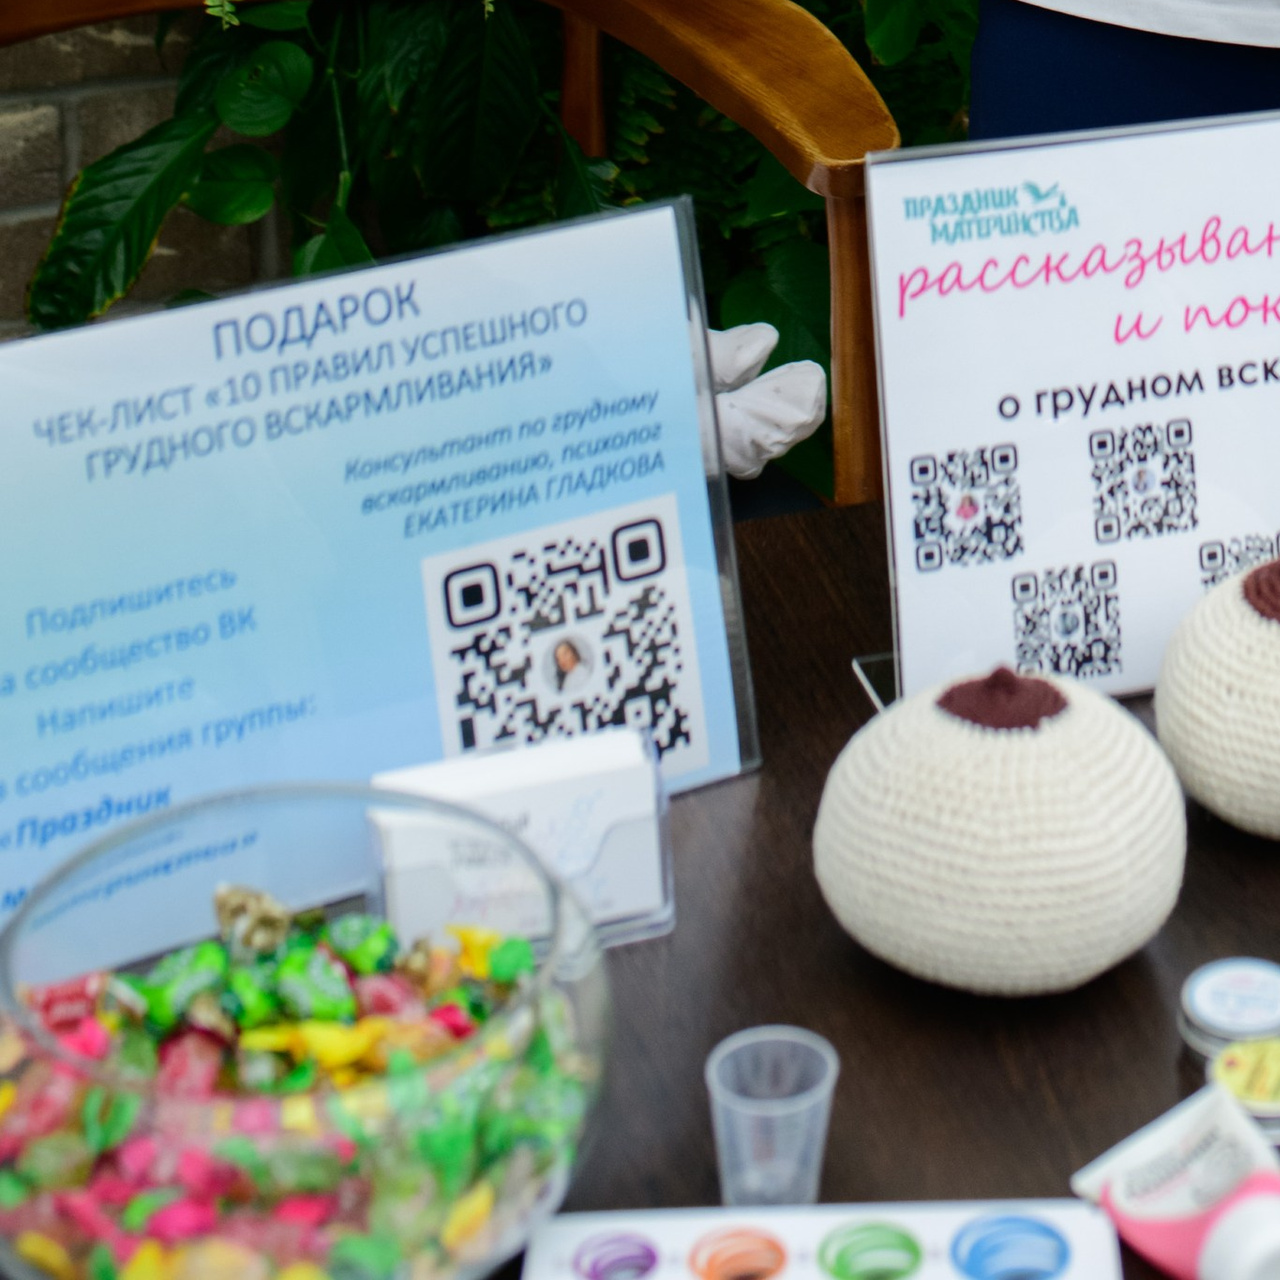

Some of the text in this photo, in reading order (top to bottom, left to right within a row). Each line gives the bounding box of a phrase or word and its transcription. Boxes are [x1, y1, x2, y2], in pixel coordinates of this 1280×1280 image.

[903, 186, 1019, 220] ПРАЗДНИК
[929, 206, 1080, 246] МАТЕРИНСТВА
[212, 279, 421, 361] ПОДАРОК
[1113, 311, 1163, 345] и
[33, 384, 196, 448] ЧЕК-ЛИСТ
[269, 340, 396, 396] ПРАВИЛ
[401, 297, 588, 367] УСПЕШНОГО
[998, 395, 1021, 421] о
[1035, 370, 1204, 421] грудном
[84, 350, 554, 482] ГРУДНОГО ВСКАРМЛИВАНИЯ»
[344, 389, 660, 484] Консультант по грудному
[361, 422, 664, 516] вскармливанию, психолог
[403, 450, 666, 539] ЕКАТЕРИНА ГЛАДКОВА
[25, 568, 238, 638] Подпишитесь
[24, 621, 212, 690] сообщество
[217, 603, 258, 640] ВК
[36, 676, 196, 738] Напишите
